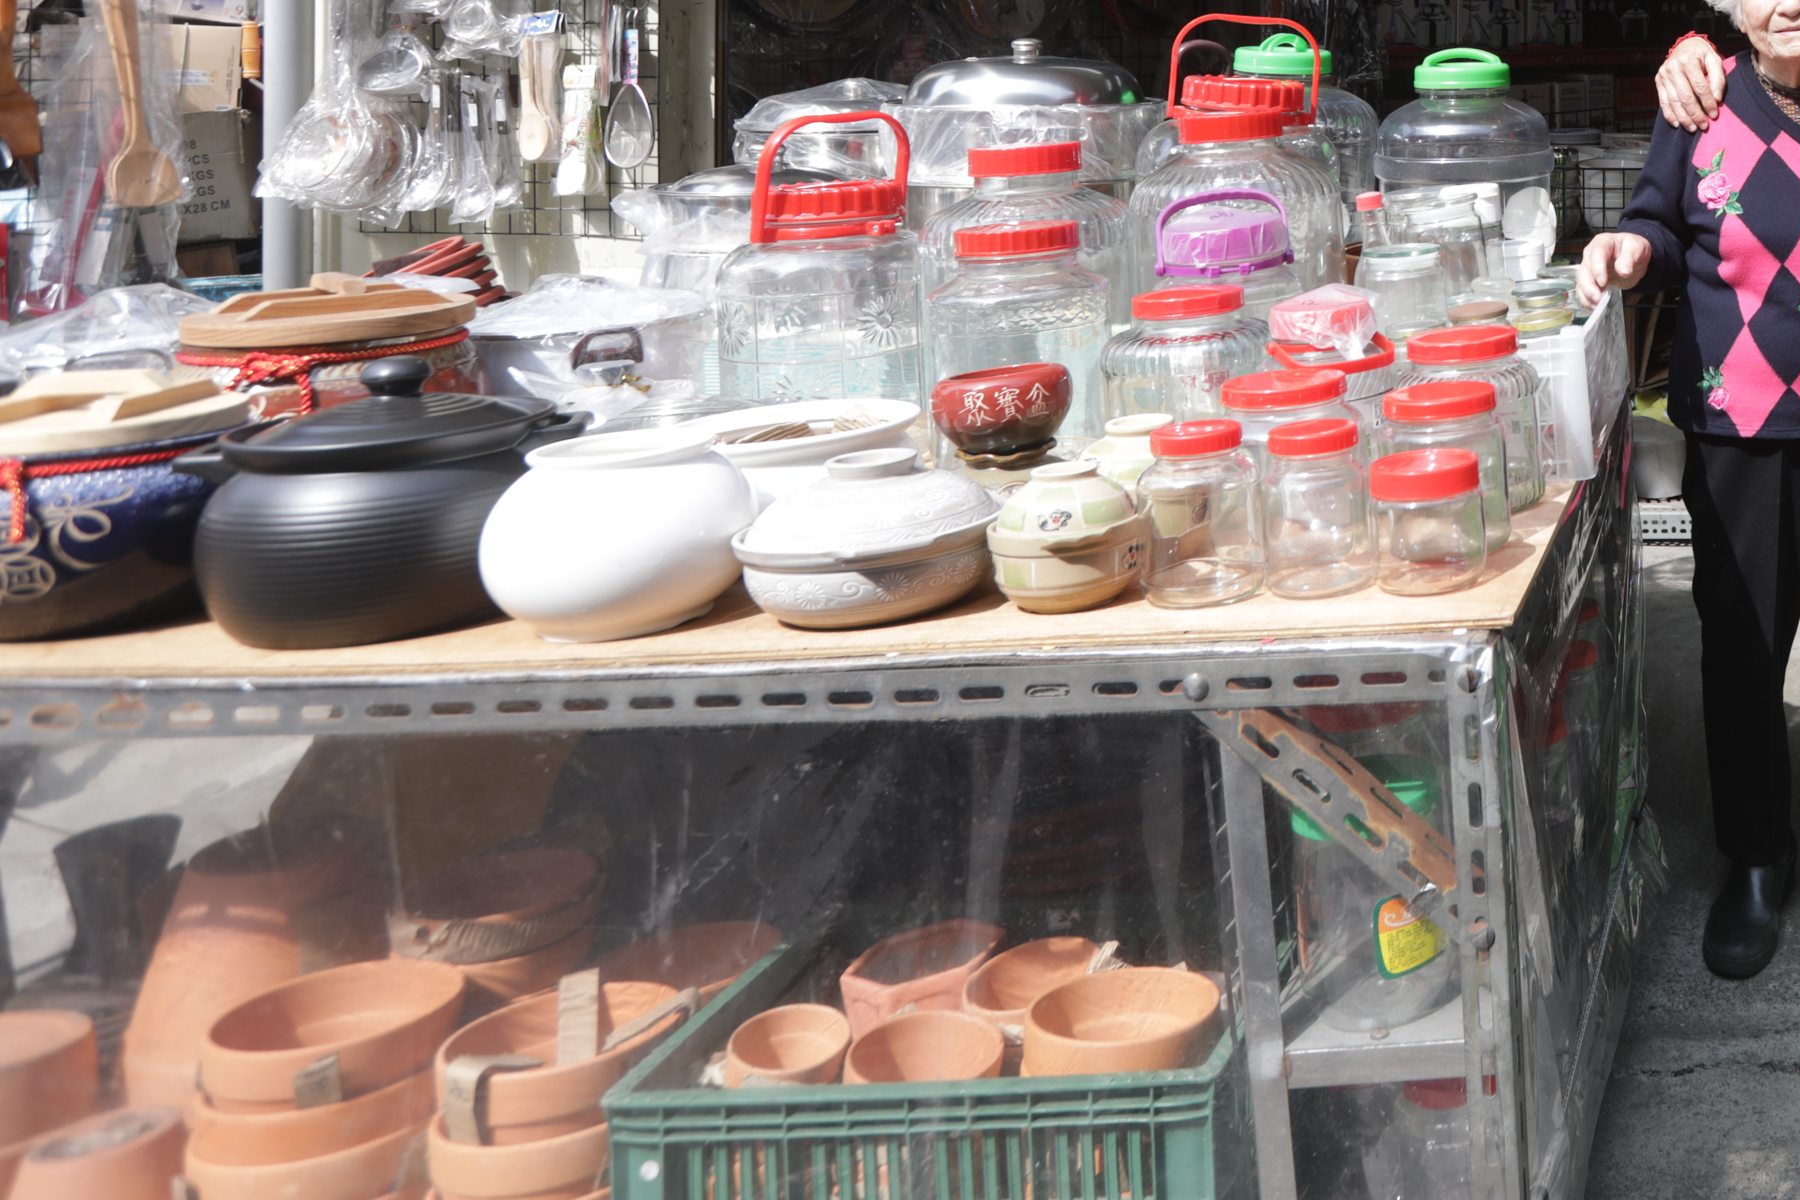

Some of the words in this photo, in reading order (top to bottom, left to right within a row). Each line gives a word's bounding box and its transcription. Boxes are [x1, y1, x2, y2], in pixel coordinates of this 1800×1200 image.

[210, 199, 231, 212] CM
[957, 382, 1051, 427] 聚寶盆
